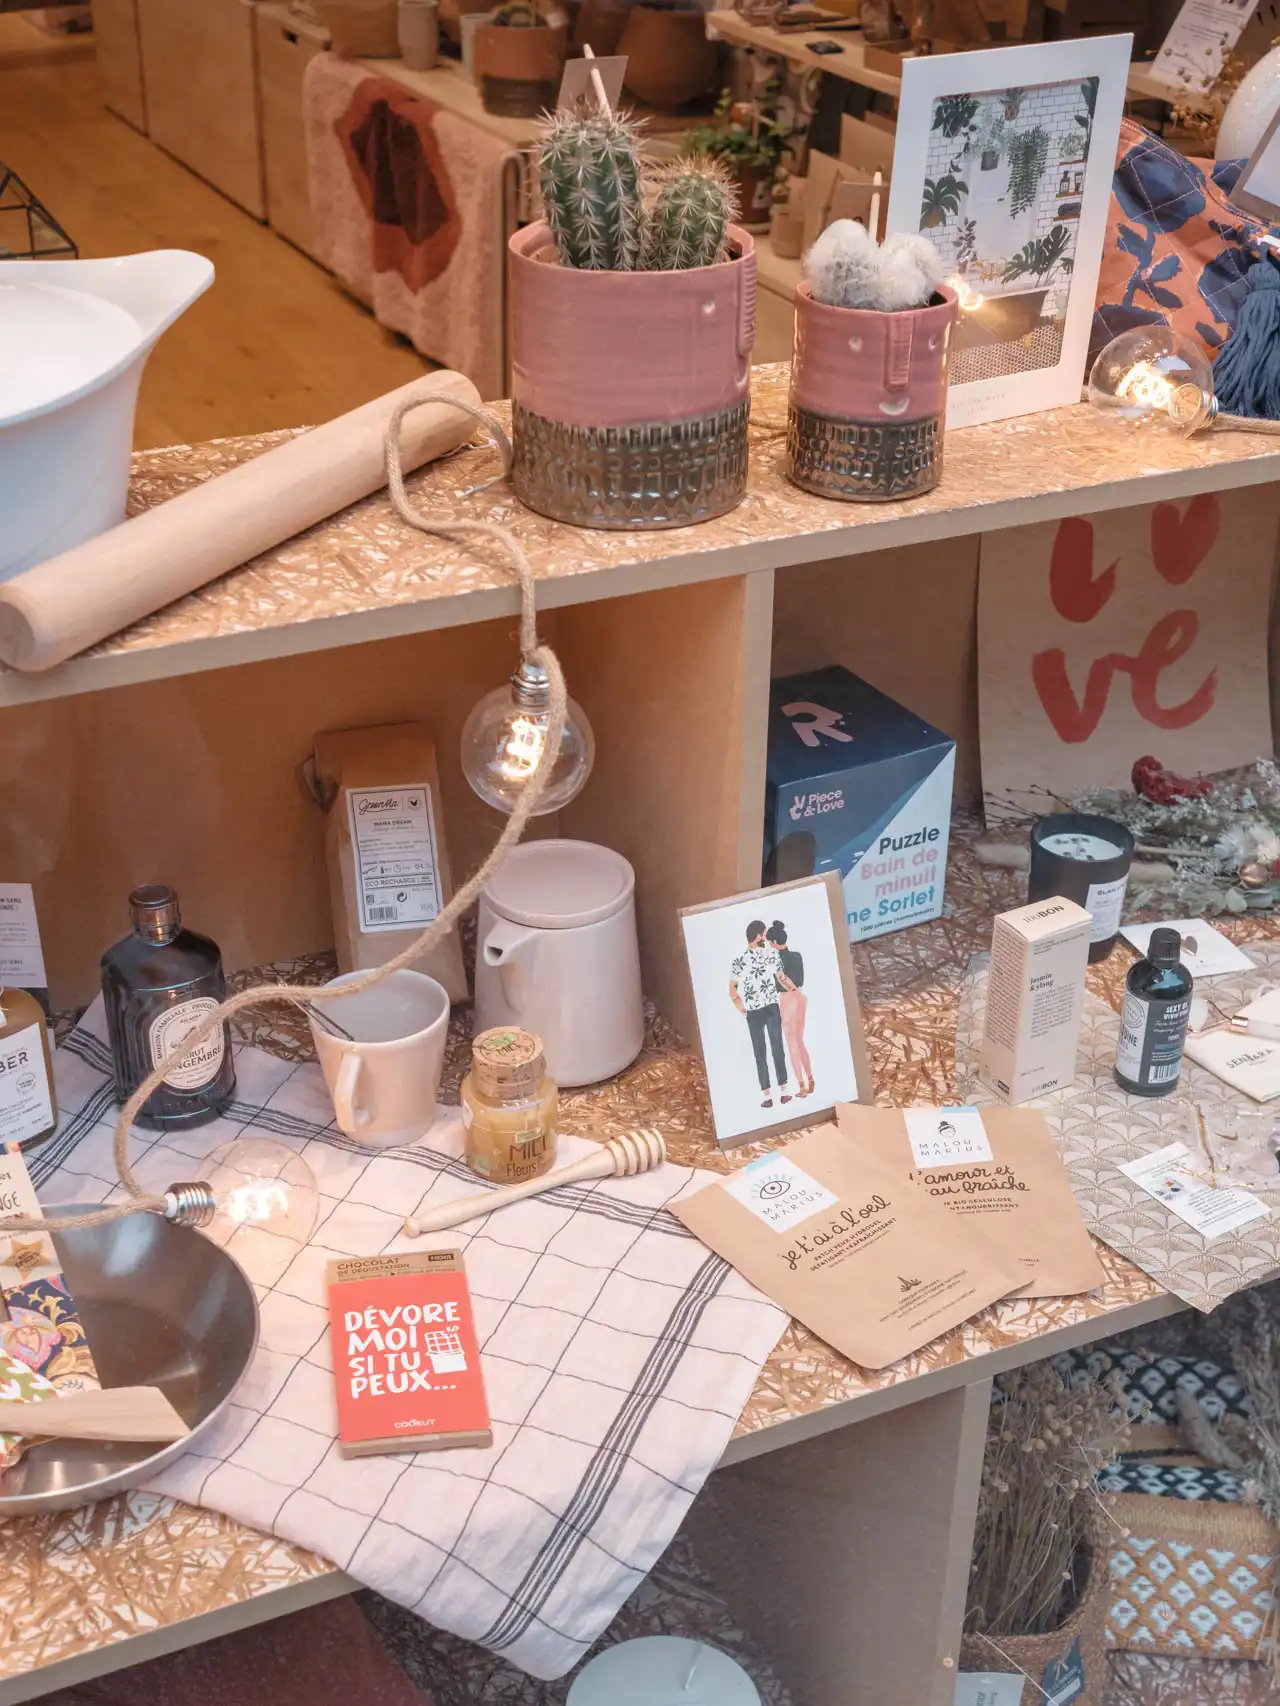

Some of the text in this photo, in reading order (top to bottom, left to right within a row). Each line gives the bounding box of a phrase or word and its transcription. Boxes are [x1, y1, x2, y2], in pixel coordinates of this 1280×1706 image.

[803, 799, 844, 817] & Love
[808, 789, 843, 805] Piece
[879, 826, 940, 855] Puzzle
[860, 847, 939, 881] Bain de
[875, 865, 937, 898] minuit
[878, 886, 936, 917] Sorlet
[860, 924, 874, 934] 1000
[157, 1008, 187, 1033] FAMILIALE
[175, 1044, 221, 1070] NGEMBRE
[509, 1135, 547, 1162] MIEL
[919, 1139, 971, 1149] MALOU
[920, 1145, 983, 1156] MARIUS
[506, 1161, 537, 1177] Fleurs
[994, 1165, 1015, 1178] et
[962, 1175, 1030, 1194] fraîche
[762, 1189, 807, 1215] MALOU
[770, 1191, 823, 1221] MARIUS
[777, 1250, 802, 1270] je
[831, 1220, 849, 1235] à
[840, 1194, 892, 1228] l'oeil
[813, 1219, 882, 1261] PATCH YEUX HYDROGEL
[337, 1258, 400, 1270] CHOCOLAT
[344, 1302, 461, 1332] DÉVORE
[347, 1326, 417, 1356] MOI
[349, 1351, 421, 1377] SI TU
[351, 1369, 457, 1399] PEUX...
